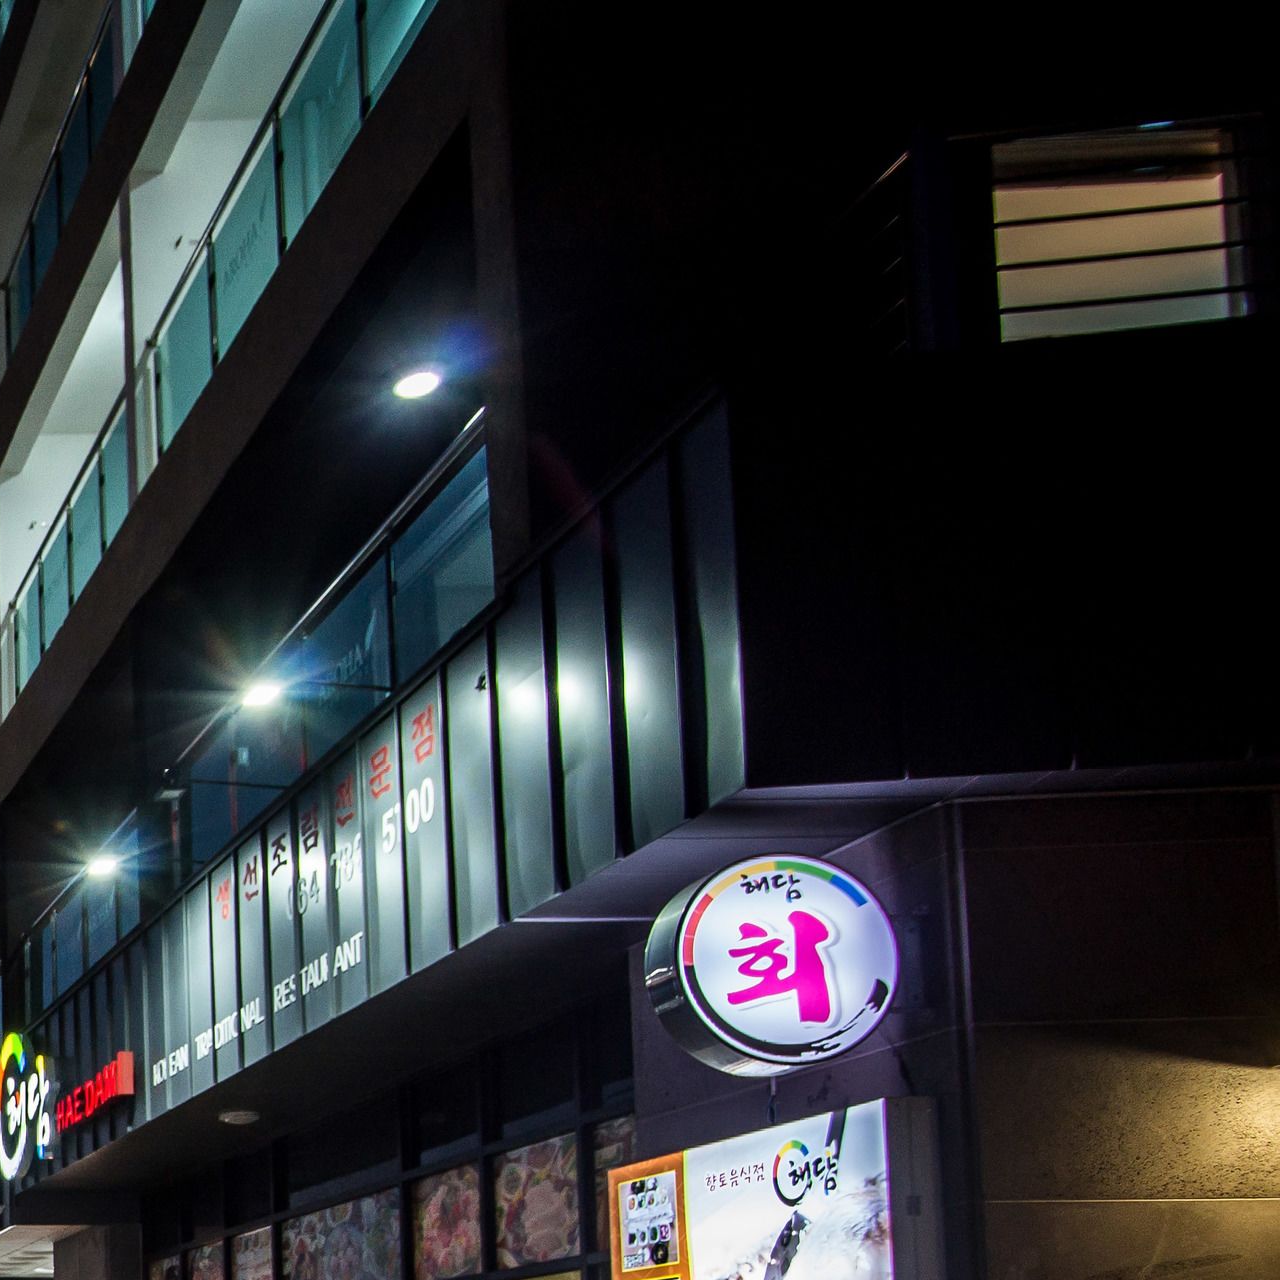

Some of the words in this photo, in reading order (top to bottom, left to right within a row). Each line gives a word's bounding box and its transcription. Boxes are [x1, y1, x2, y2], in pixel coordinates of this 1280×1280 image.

[739, 870, 803, 905] 해담
[726, 909, 831, 1024] 회
[705, 1162, 766, 1192] 향토음식점
[788, 1150, 839, 1197] 해담
